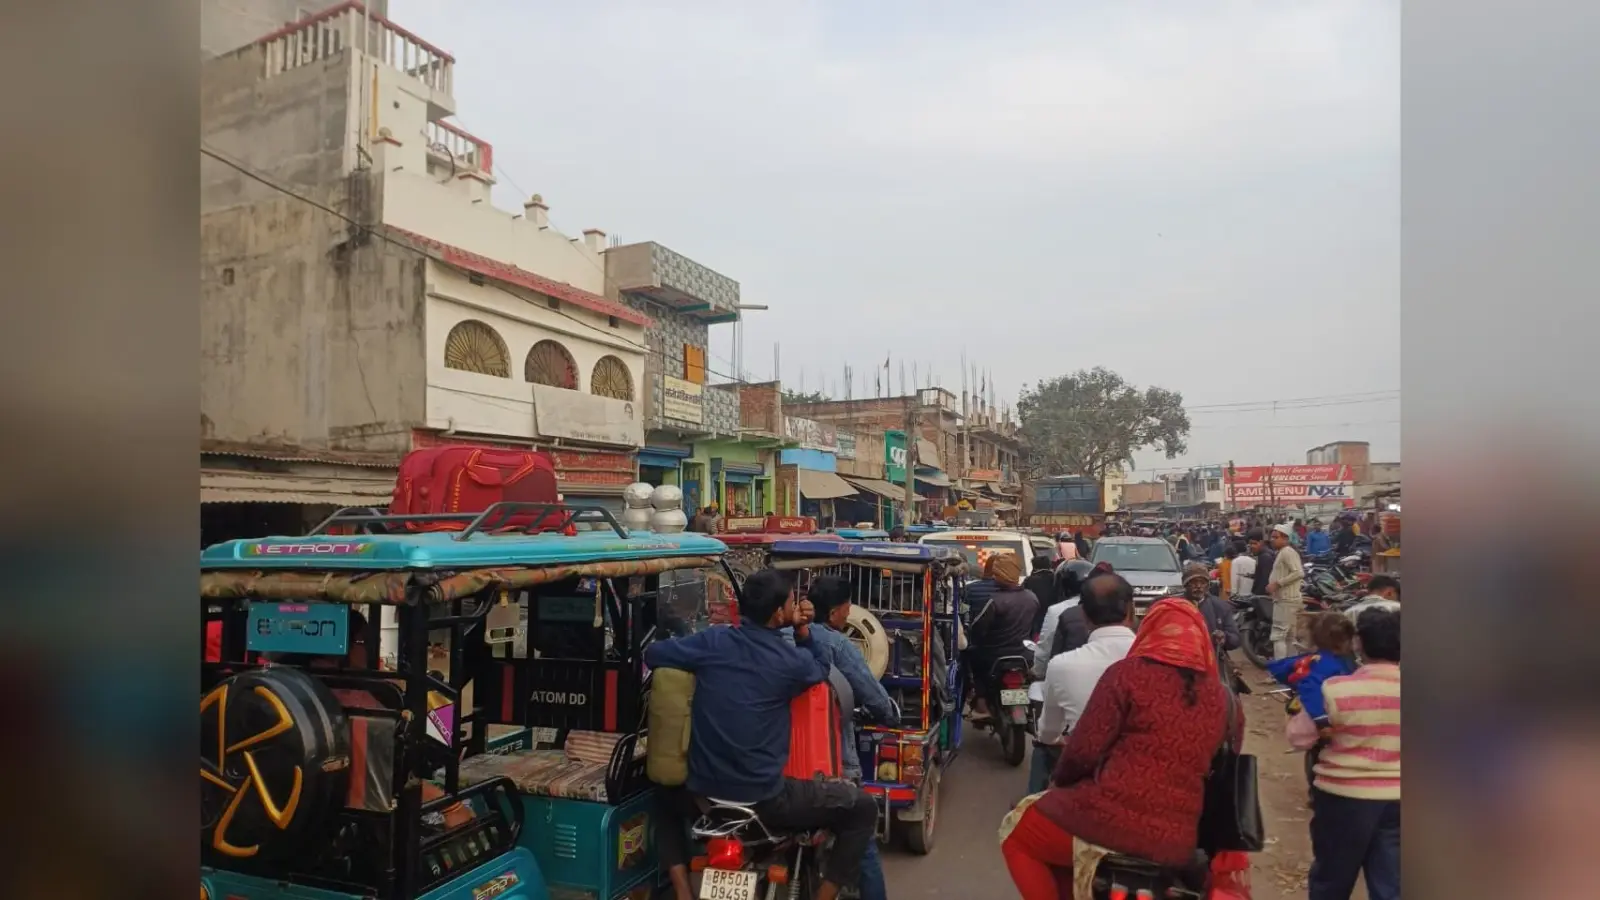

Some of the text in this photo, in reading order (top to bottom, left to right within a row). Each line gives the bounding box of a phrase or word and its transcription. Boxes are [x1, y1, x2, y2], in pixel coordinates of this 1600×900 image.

[266, 543, 350, 554] ETRON
[256, 617, 337, 638] ERON
[530, 690, 587, 706] ATOM DD
[712, 870, 749, 887] BR50A
[710, 885, 749, 900] D9459
